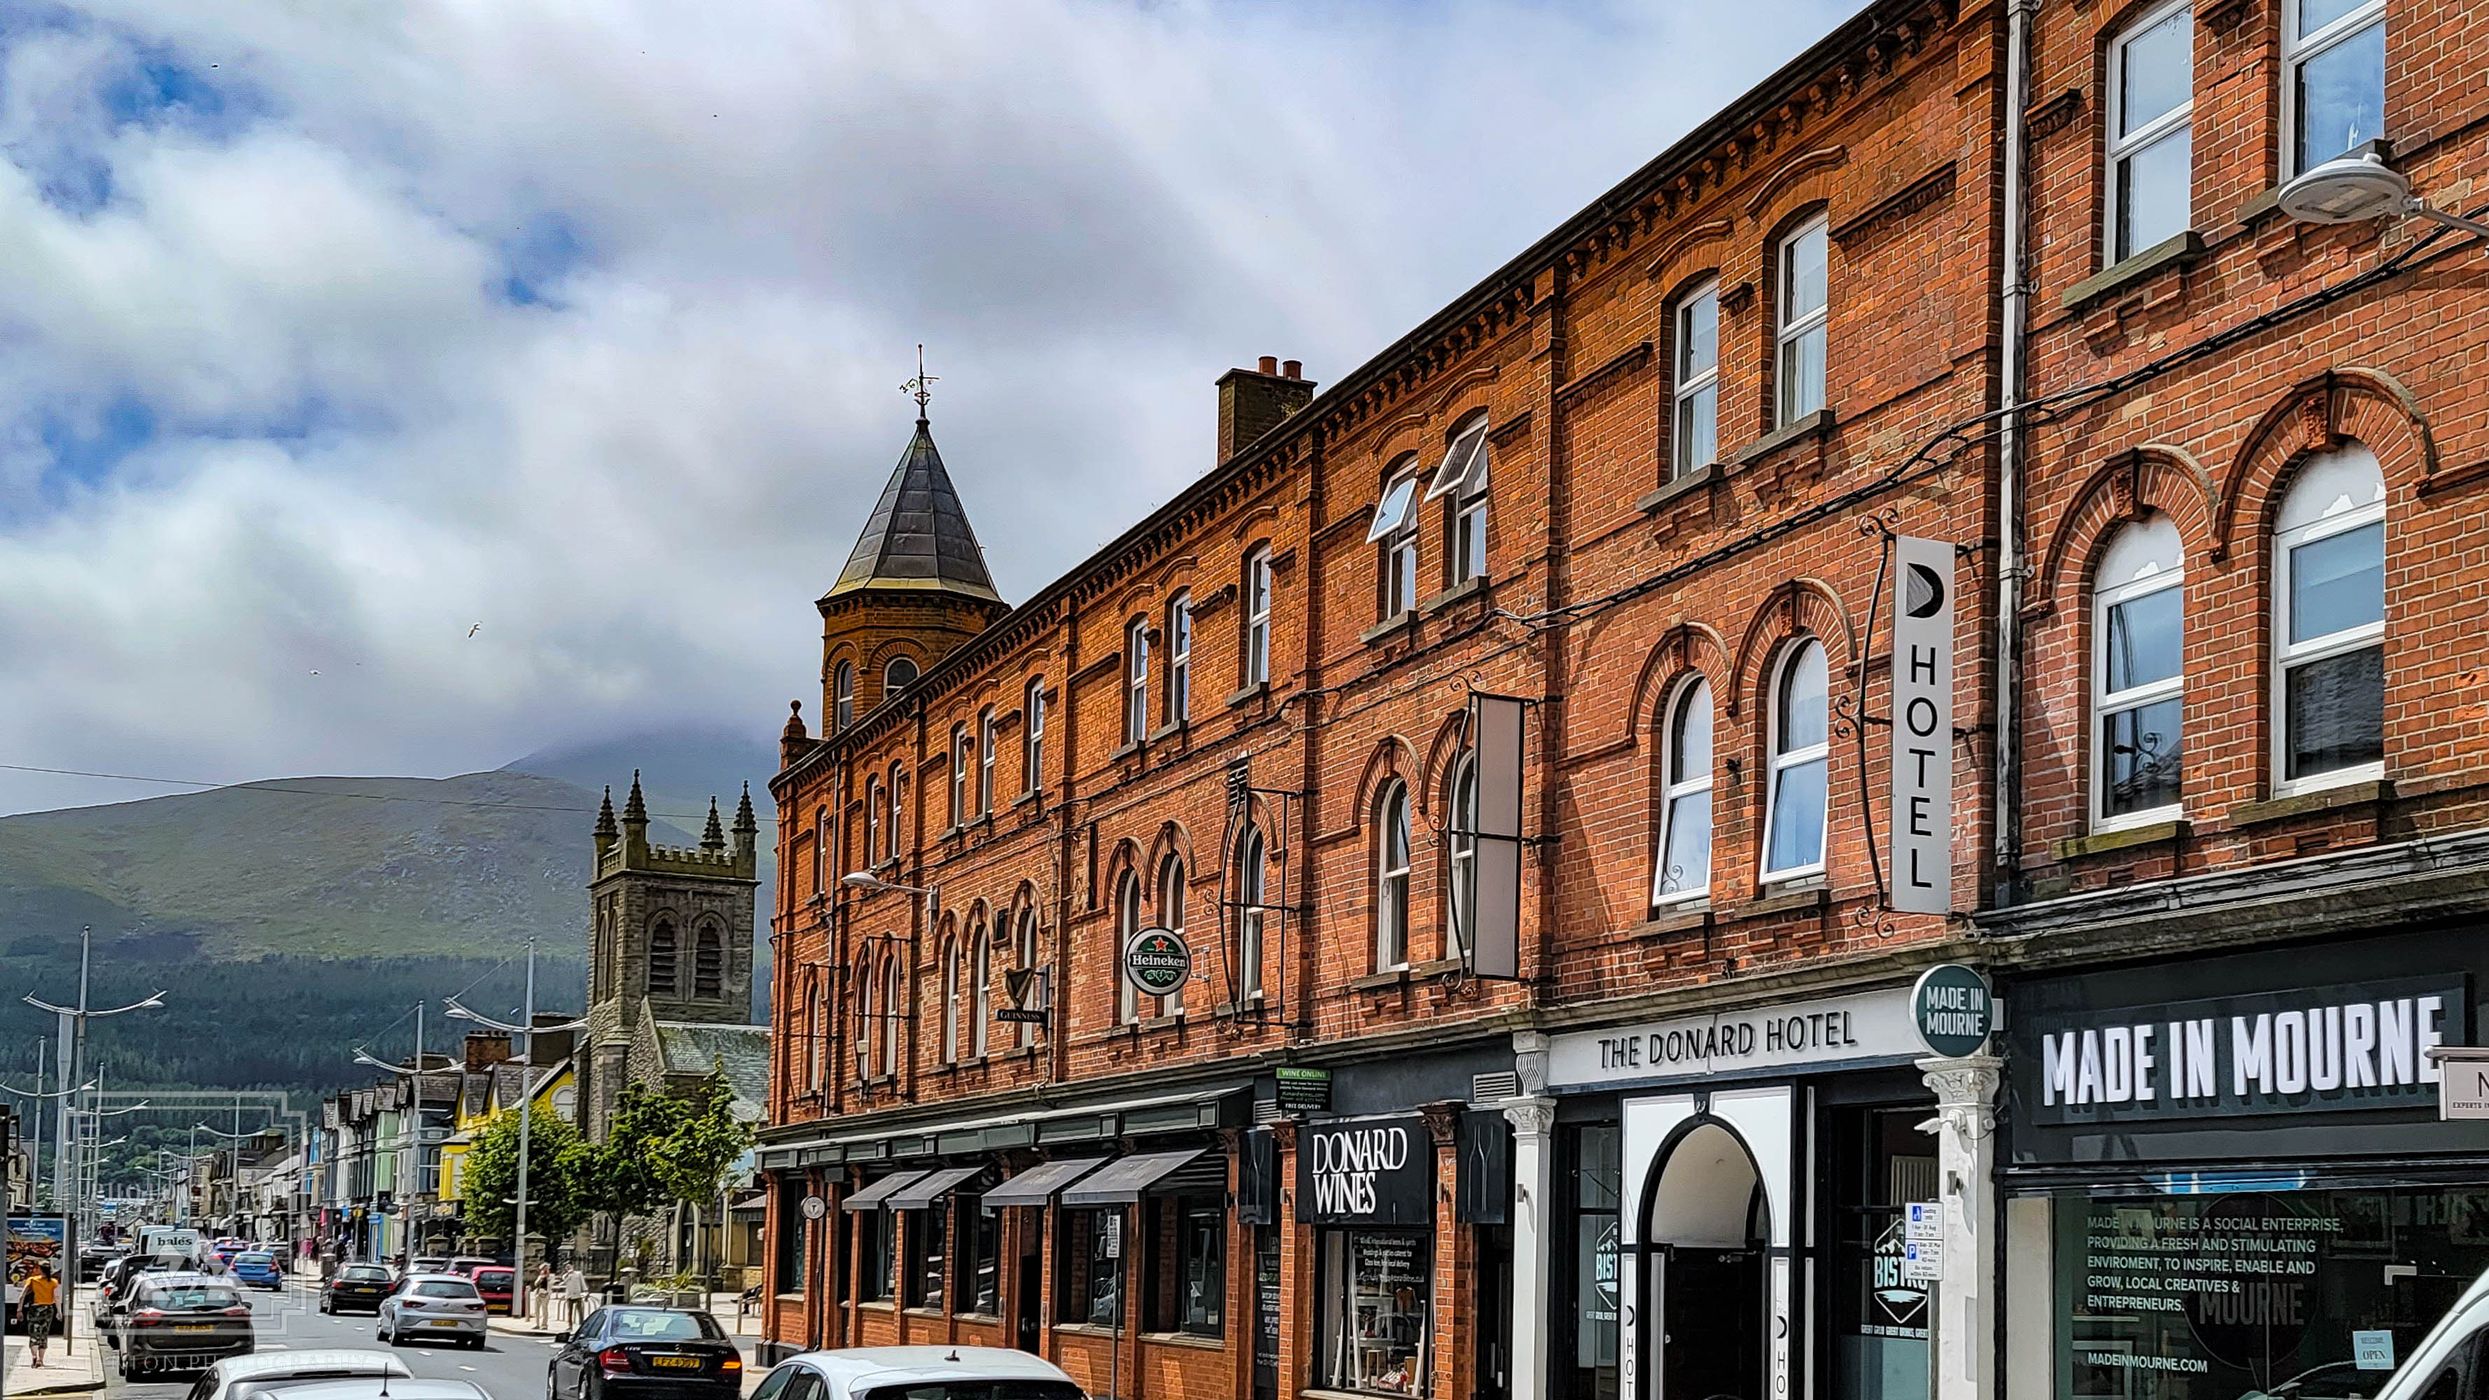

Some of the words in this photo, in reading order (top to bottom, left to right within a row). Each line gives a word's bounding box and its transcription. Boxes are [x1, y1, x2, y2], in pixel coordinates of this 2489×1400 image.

[1906, 644, 1938, 889] HOTEL
[1132, 953, 1186, 968] Heineken
[1926, 986, 1967, 1011] MADE
[1969, 986, 1984, 1012] IN
[1000, 1010, 1041, 1021] GUINNESS
[1926, 1010, 1984, 1037] MOURNE
[1598, 1035, 1641, 1070] THE
[1648, 1022, 1755, 1065] DONARD
[1766, 1010, 1857, 1052] HOTEL
[2043, 1024, 2156, 1106] MADE
[2169, 1018, 2217, 1099] IN
[2232, 996, 2444, 1096] MOURNE
[1281, 1069, 1300, 1078] WINE
[1313, 1127, 1408, 1174] DONARD
[1313, 1171, 1376, 1215] WINES
[2087, 1216, 2119, 1229] MADE
[2188, 1218, 2200, 1230] IS
[2203, 1218, 2212, 1230] A
[2214, 1218, 2258, 1231] SOCIAL
[2262, 1218, 2344, 1233] ENTERPRISE,
[2087, 1236, 2148, 1249] PROVIDING
[2150, 1238, 2159, 1249] A
[2161, 1238, 2199, 1250] FRESH
[2202, 1239, 2229, 1251] AND
[2231, 1239, 2316, 1252] STIMULATING
[2087, 1256, 2162, 1272] ENVIROMENT,
[2164, 1258, 2180, 1270] TO
[2183, 1258, 2232, 1273] INSPIRE,
[2235, 1260, 2284, 1273] ENABLE
[2286, 1261, 2316, 1274] AND
[2087, 1276, 2123, 1291] GROW,
[2126, 1277, 2162, 1290] LOCAL
[2164, 1279, 2229, 1292] CREATIVES
[2231, 1280, 2240, 1293] &
[2087, 1294, 2185, 1312] ENTREPRENEURS.
[2087, 1352, 2208, 1373] MADEINMOURNE.COM
[2363, 1350, 2386, 1360] OPEN
[1776, 1351, 1787, 1400] HO
